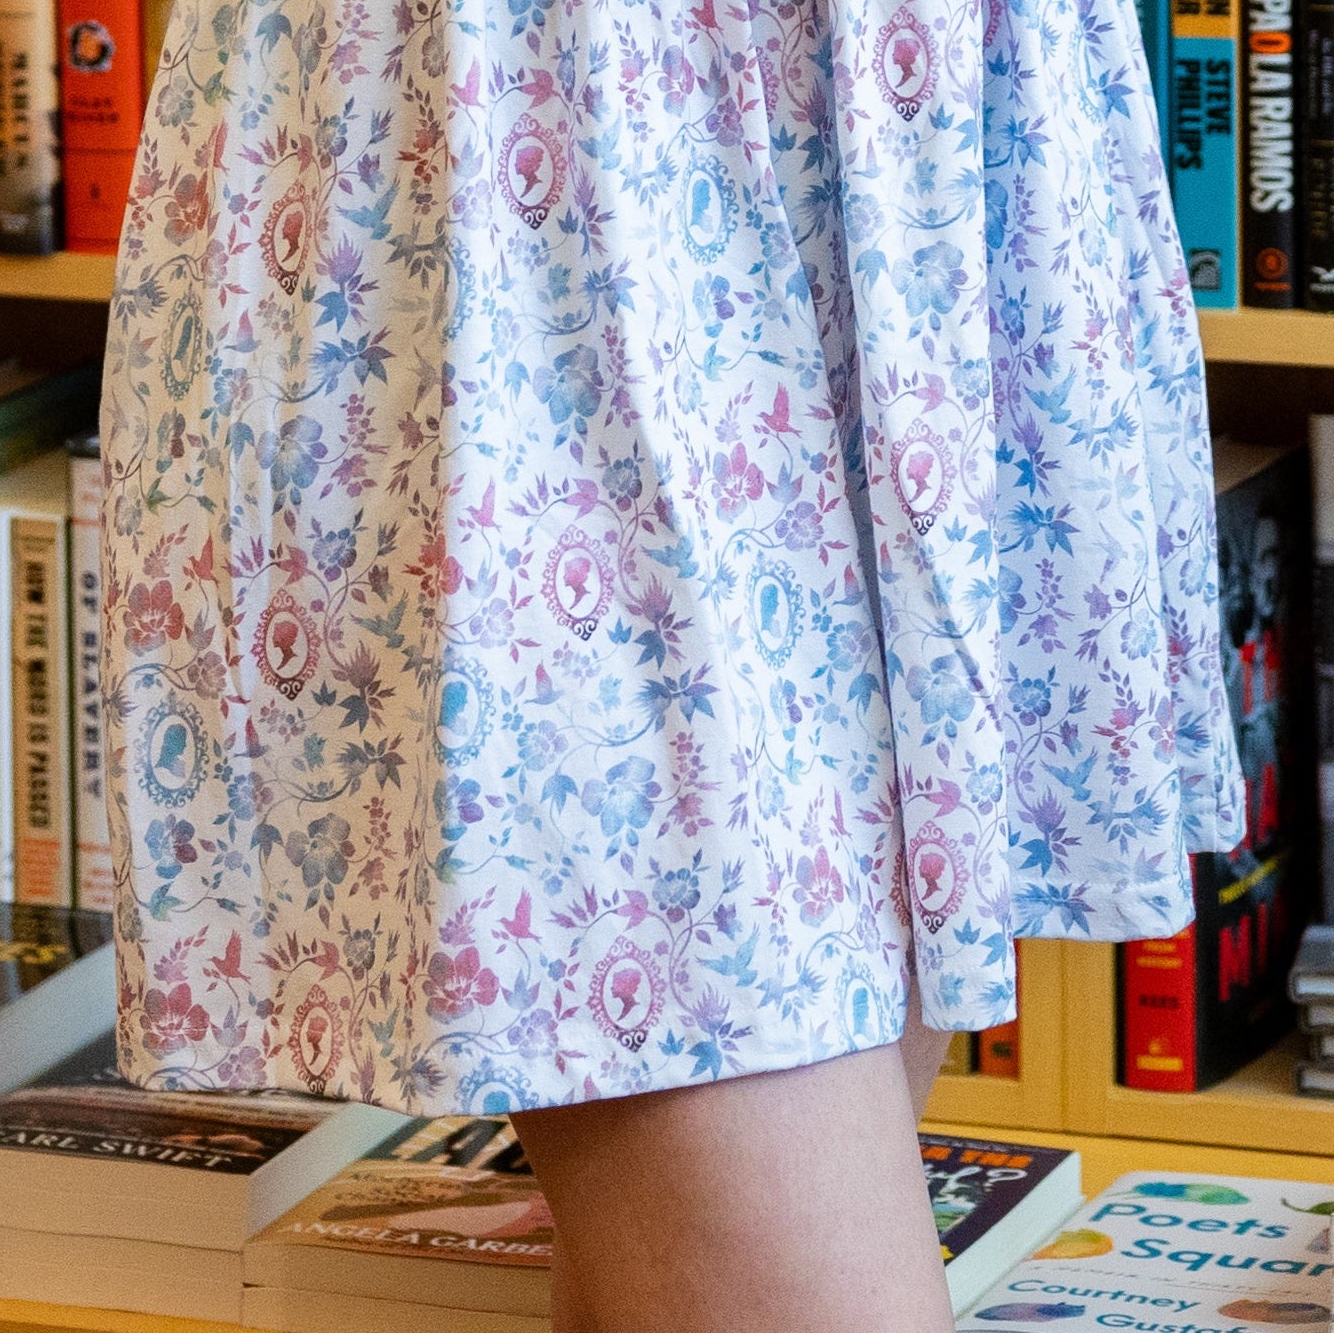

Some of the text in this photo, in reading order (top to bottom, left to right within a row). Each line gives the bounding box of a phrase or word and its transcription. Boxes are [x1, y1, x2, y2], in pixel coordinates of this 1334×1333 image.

[1250, 109, 1292, 213] RAMOS
[97, 1136, 234, 1166] SWIFT
[1089, 1203, 1289, 1240] Poets
[1120, 1238, 1333, 1276] Squar
[1008, 1280, 1202, 1312] Courtney
